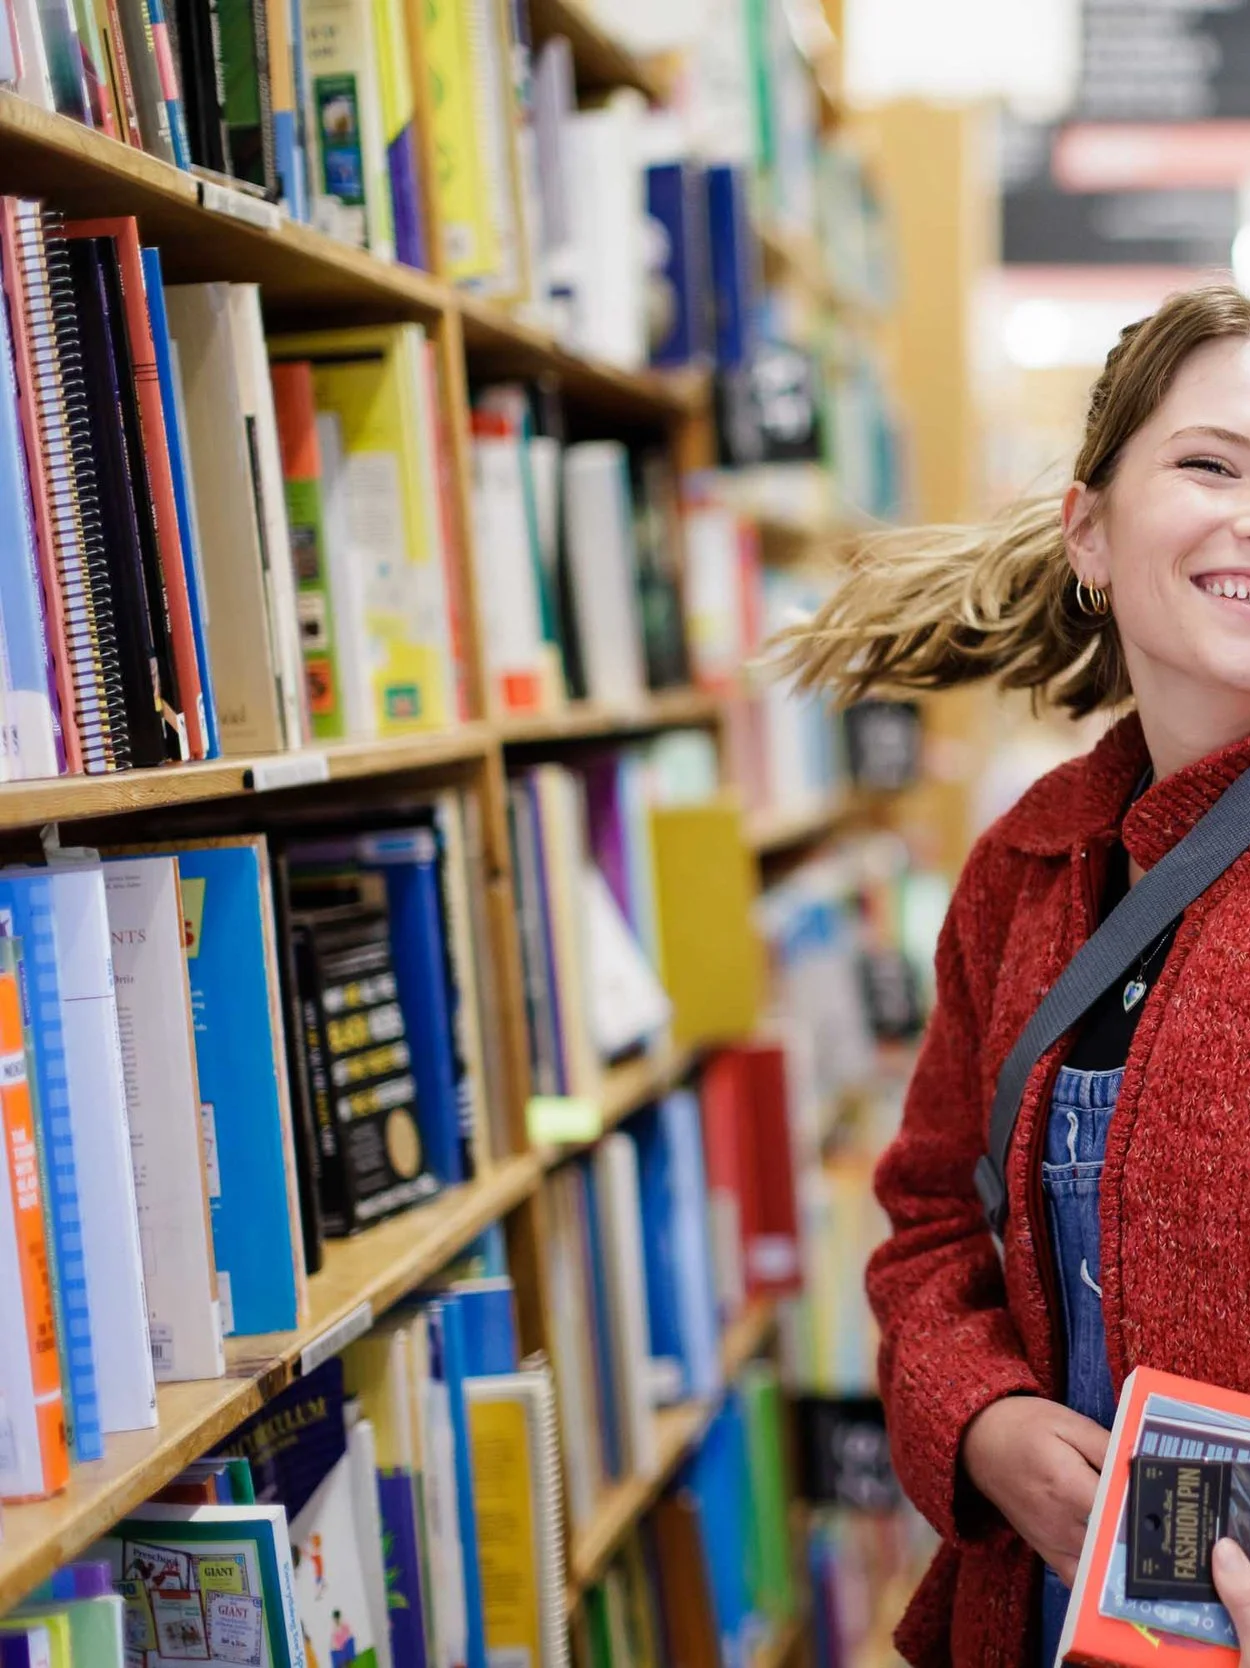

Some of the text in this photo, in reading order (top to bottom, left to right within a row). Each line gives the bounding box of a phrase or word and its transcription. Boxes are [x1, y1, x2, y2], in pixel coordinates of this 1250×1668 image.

[111, 928, 147, 945] NTS
[1174, 1466, 1202, 1578] FASHION PIN
[204, 1566, 235, 1577] GIANT
[218, 1604, 248, 1619] GIANT
